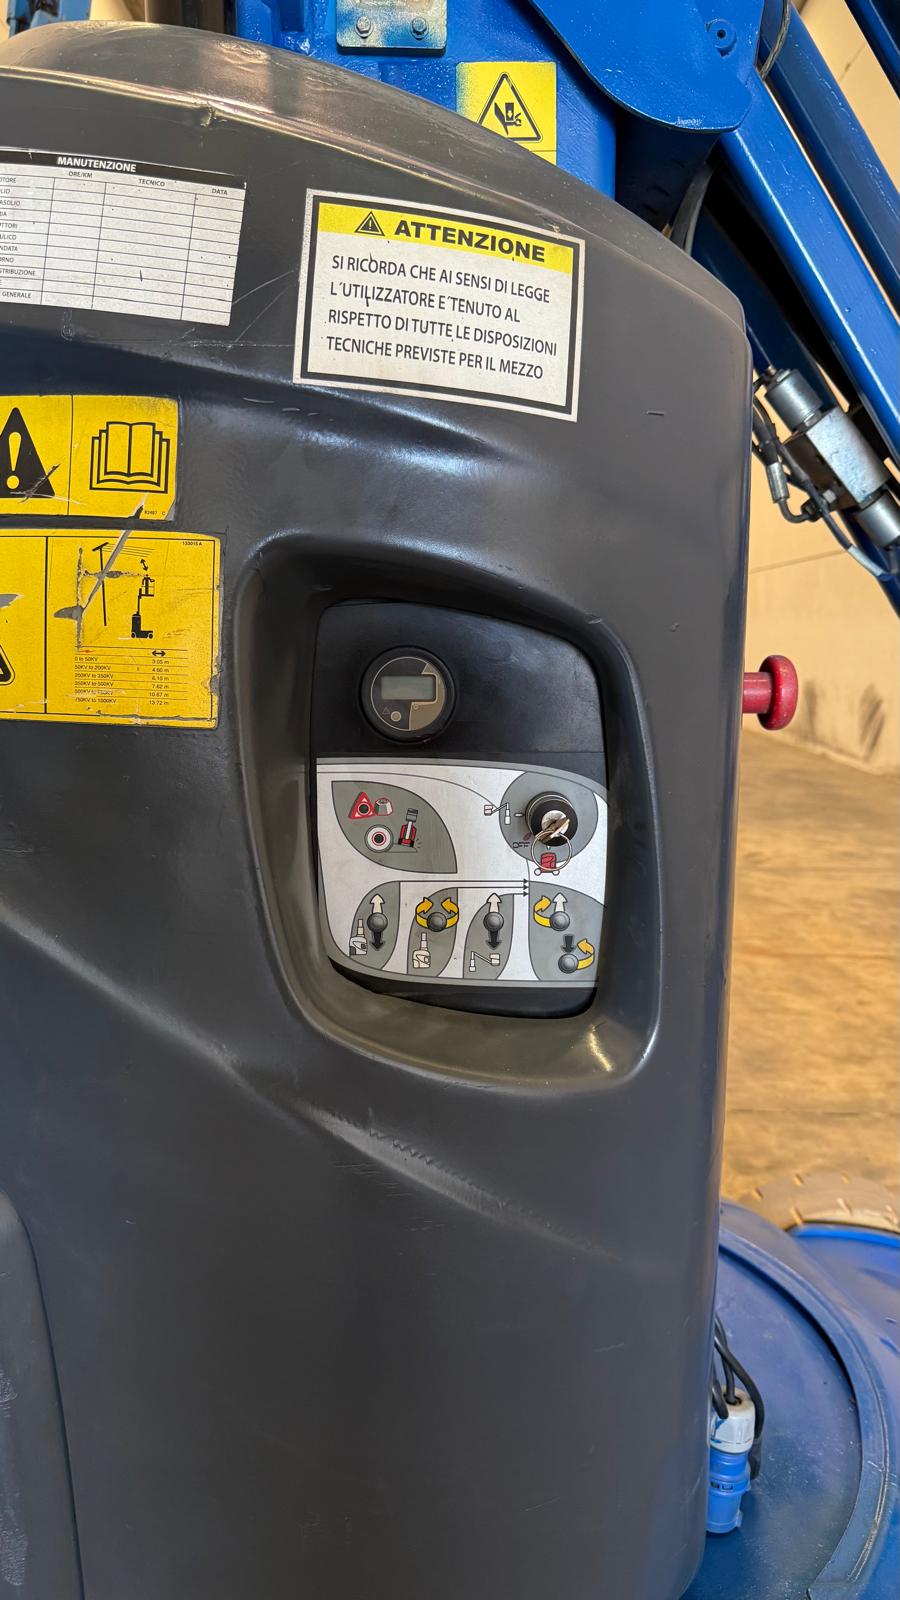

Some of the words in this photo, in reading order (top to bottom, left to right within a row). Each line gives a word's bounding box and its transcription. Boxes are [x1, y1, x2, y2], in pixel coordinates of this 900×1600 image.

[57, 156, 136, 172] MANUTENZIONE
[138, 178, 166, 187] TECNICO
[394, 219, 546, 263] ATTENZIONE
[332, 255, 344, 270] SI
[348, 258, 406, 278] RICORDA
[410, 264, 436, 282] CHE
[440, 268, 452, 284] AI
[456, 272, 492, 290] SENSI
[495, 278, 508, 294] DI
[511, 282, 550, 304] LEGGE
[328, 310, 392, 330] RISPETTO
[395, 316, 408, 332] DI
[412, 319, 453, 338] TUTTE
[456, 325, 470, 340] LE
[474, 328, 557, 356] DISPOSIZIONI
[505, 308, 520, 323] AL
[326, 336, 392, 357] TECNICHE
[396, 344, 456, 365] PREVISTE
[460, 352, 482, 370] PER
[486, 356, 496, 372] IL
[500, 359, 544, 380] MEZZO
